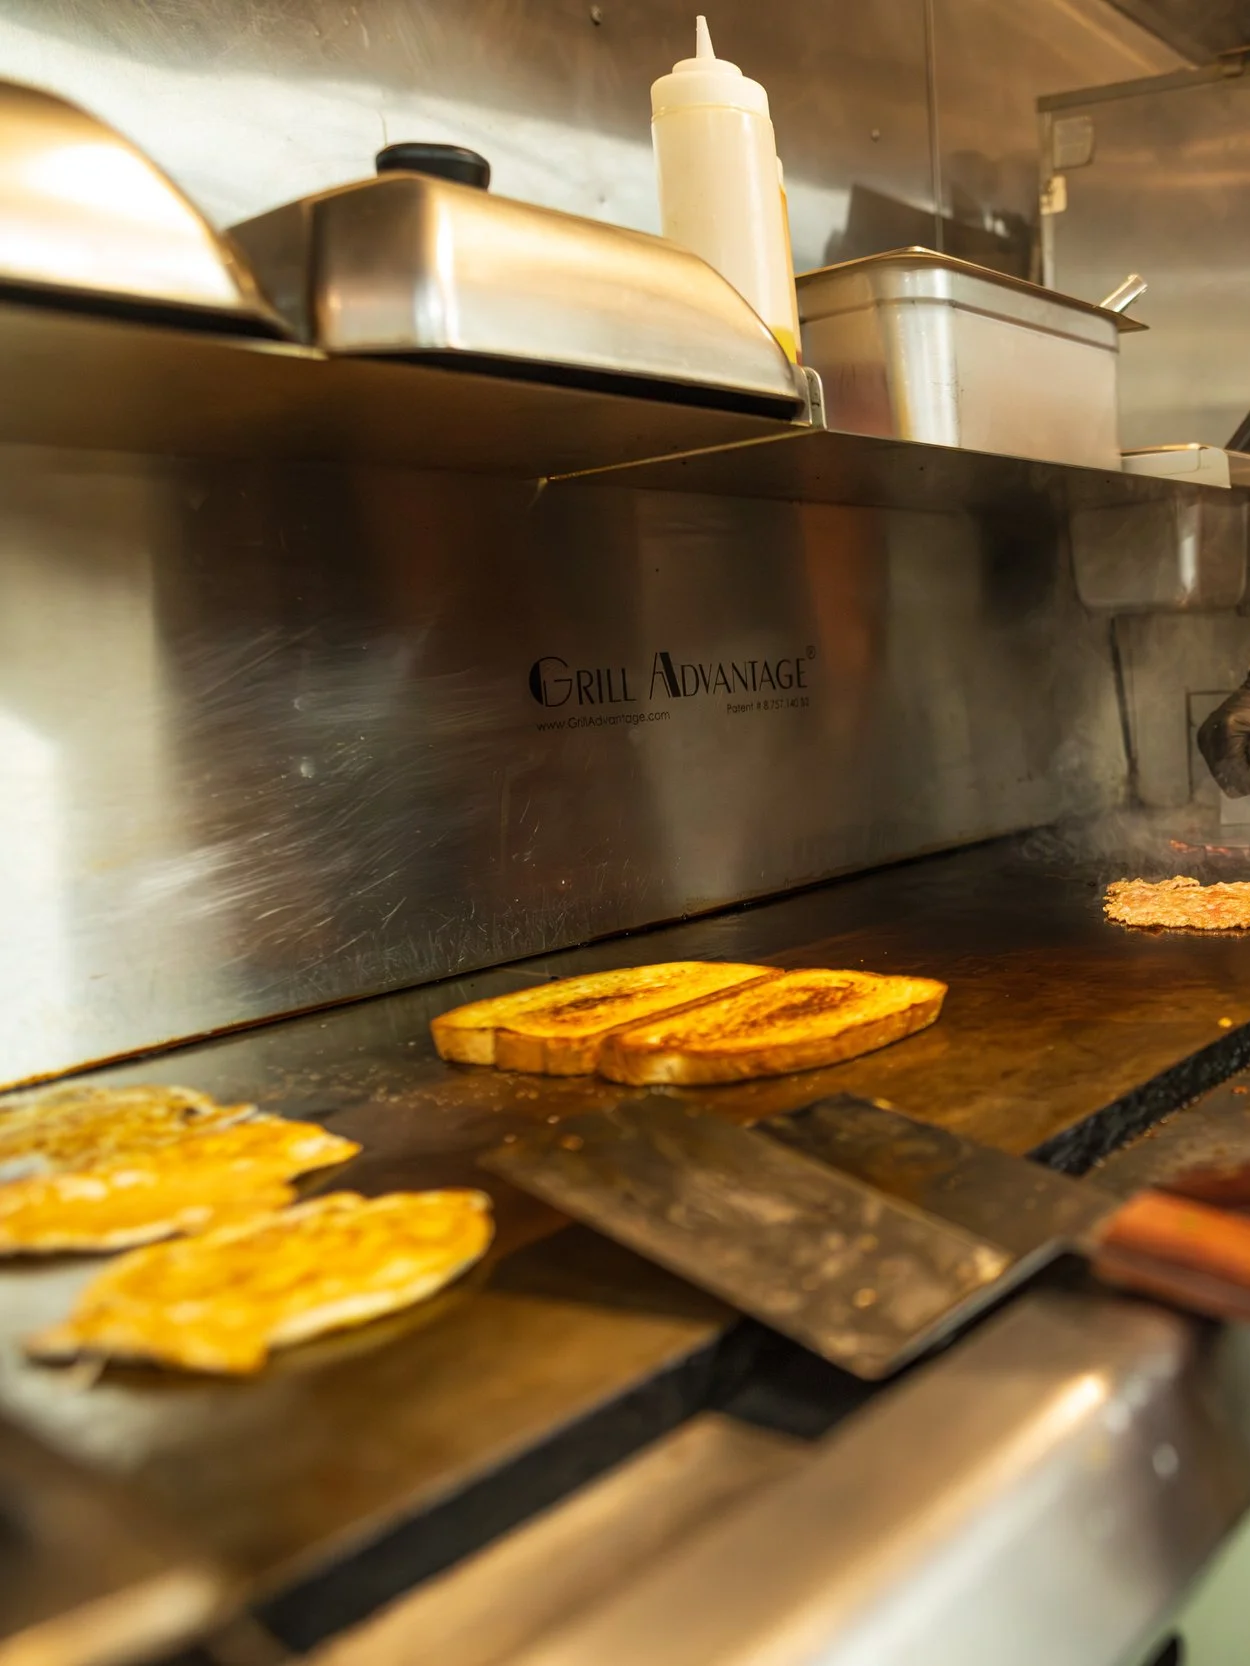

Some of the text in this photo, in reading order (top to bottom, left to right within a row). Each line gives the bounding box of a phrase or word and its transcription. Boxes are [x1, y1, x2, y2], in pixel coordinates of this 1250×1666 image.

[529, 656, 637, 707] GRILL
[726, 702, 753, 715] Patent
[536, 710, 671, 732] www.GrillAdvantage.com
